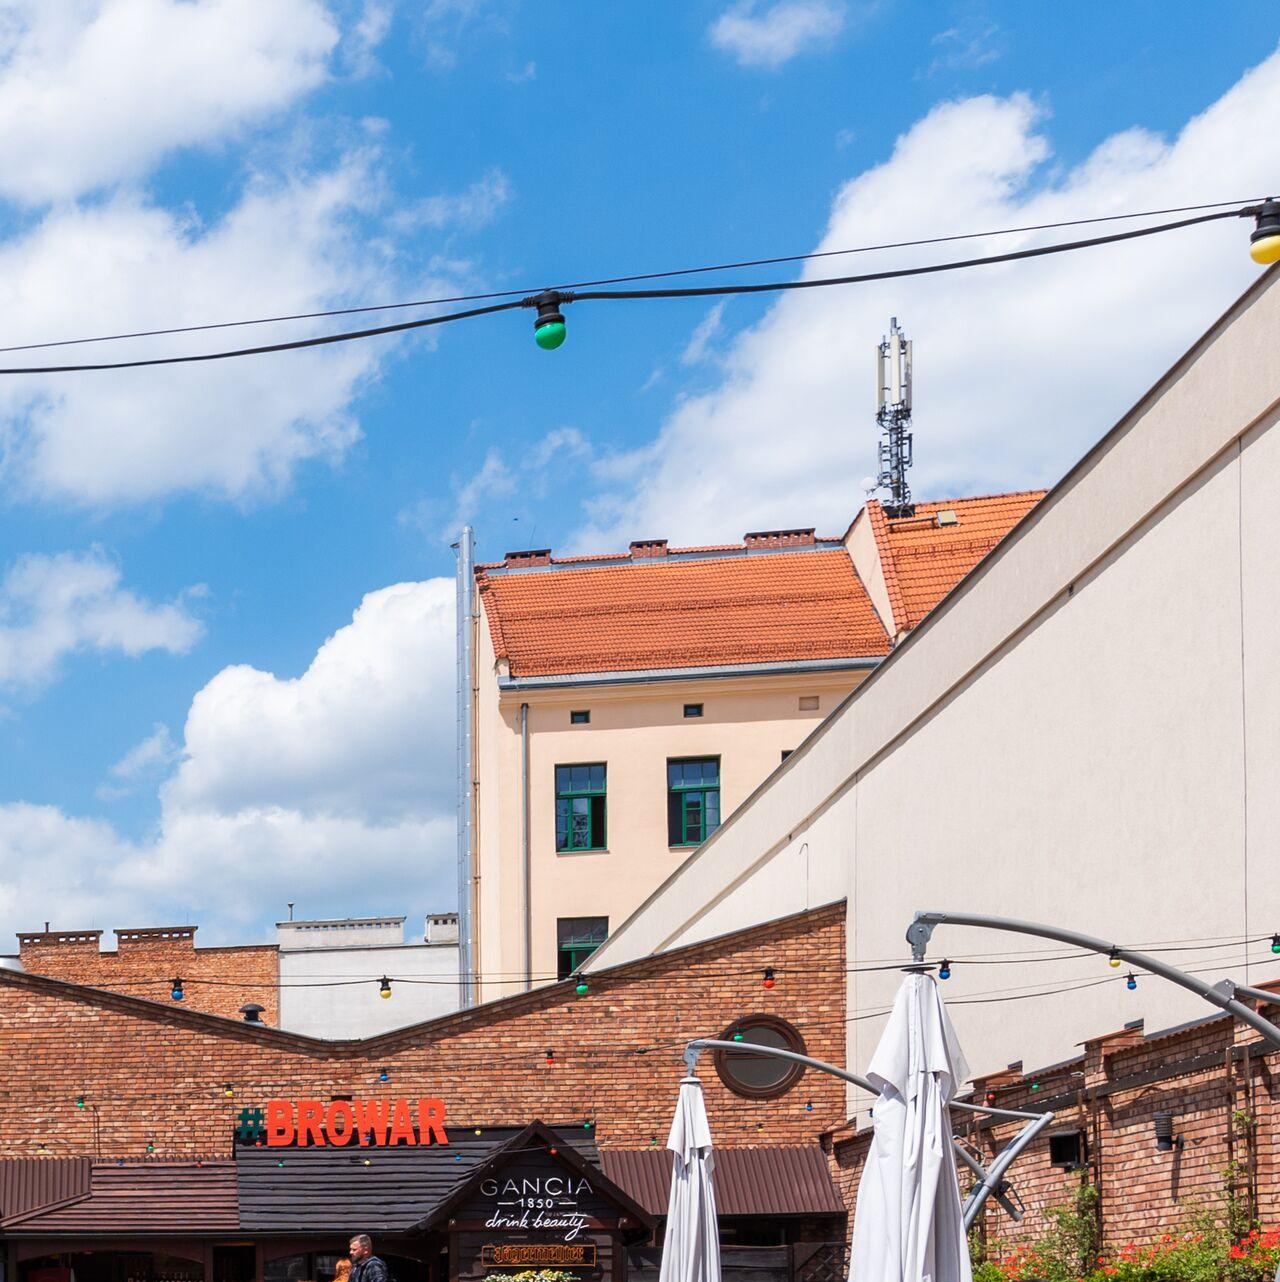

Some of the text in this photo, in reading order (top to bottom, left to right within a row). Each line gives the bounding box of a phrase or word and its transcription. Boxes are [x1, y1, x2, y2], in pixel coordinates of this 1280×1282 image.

[238, 1100, 449, 1148] #BROWAR
[480, 1177, 594, 1196] GANCIA
[520, 1198, 554, 1209] 1850
[485, 1209, 591, 1241] drink beauty
